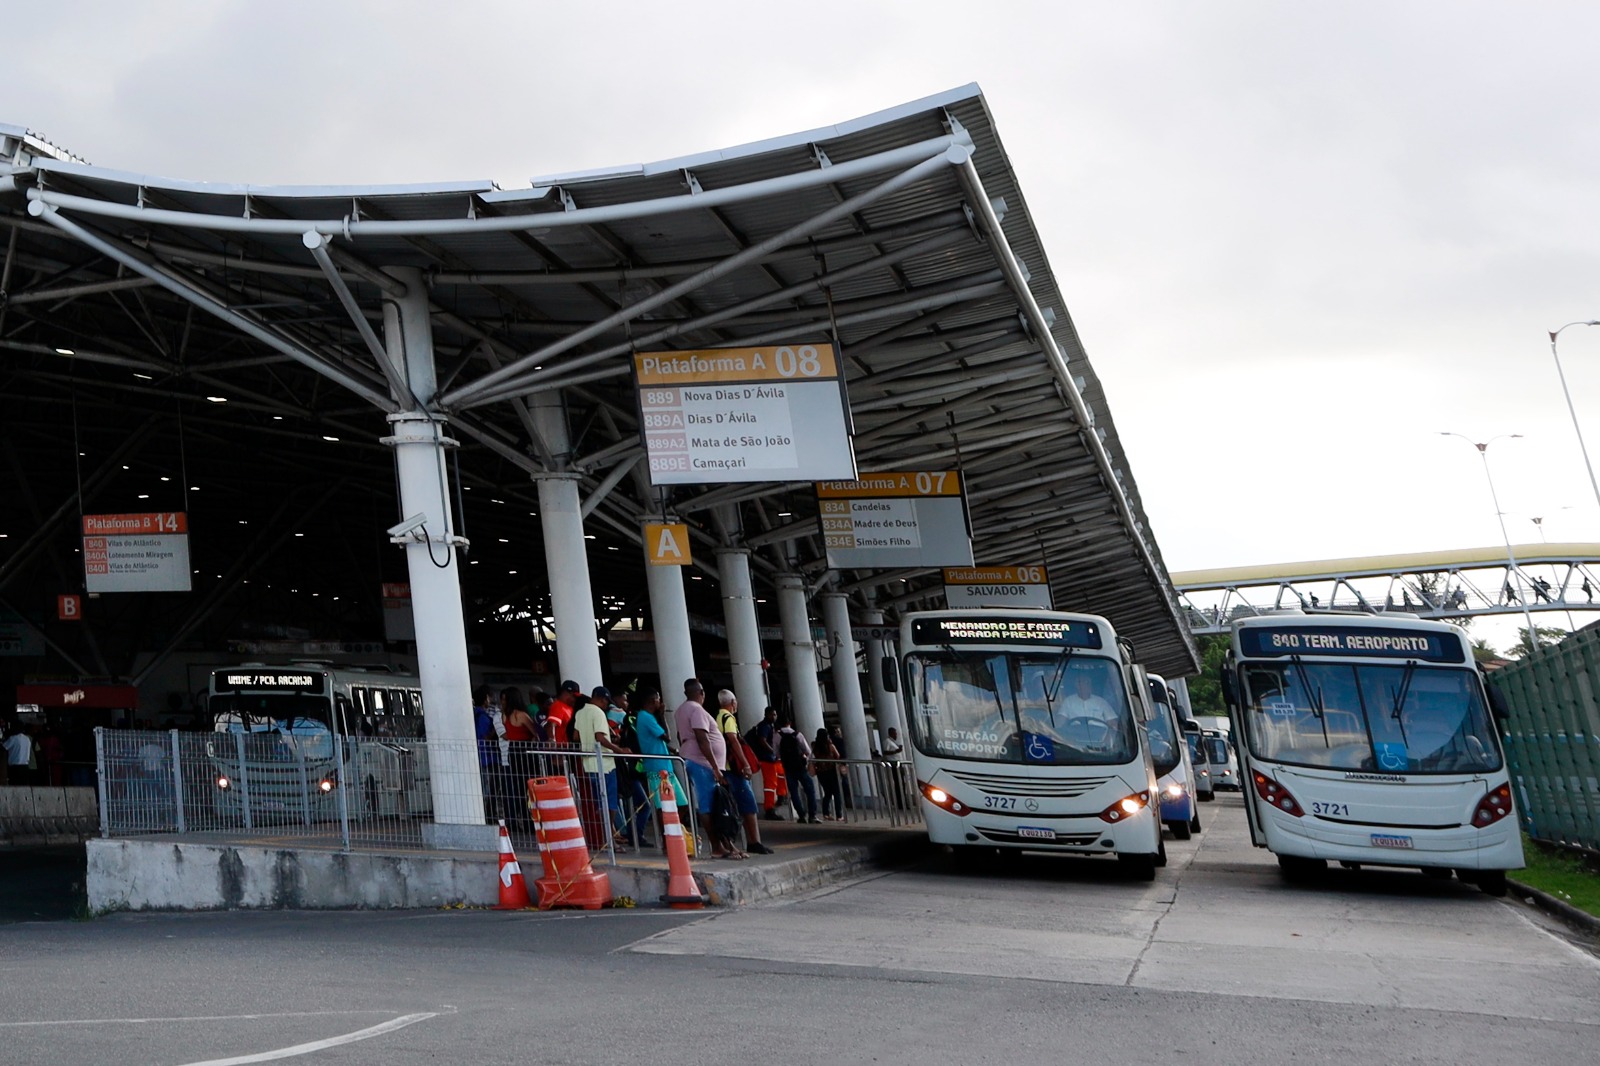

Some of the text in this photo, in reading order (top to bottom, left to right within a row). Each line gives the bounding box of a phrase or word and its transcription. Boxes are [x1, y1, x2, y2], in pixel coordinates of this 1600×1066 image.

[642, 345, 821, 377] Plataforma A 08
[646, 391, 674, 404] 889
[684, 390, 712, 402] Nova
[716, 389, 740, 400] Dias
[644, 412, 684, 428] 889A
[688, 413, 712, 424] Dias
[648, 438, 686, 450] 889A2
[691, 435, 792, 448] Mata de São João
[651, 458, 688, 471] 889E
[692, 456, 746, 472] Camaçari
[821, 472, 947, 494] Plataforma A 07
[824, 502, 845, 513] 834
[852, 502, 891, 512] Candeias
[87, 514, 178, 532] Plataforma B 14
[823, 520, 851, 530] 834A
[854, 518, 918, 529] Madre de Deus
[133, 539, 162, 547] Atlântico
[657, 528, 682, 558] A
[825, 536, 852, 547] 834E
[856, 536, 911, 546] Simões Filho
[146, 552, 174, 560] Miragem
[948, 567, 1041, 583] Plataforma A 06
[966, 585, 1027, 596] SALVADOR
[64, 598, 76, 616] B
[940, 622, 1070, 632] MENANDRO DE FARIA
[950, 630, 1063, 639] MORADA PREMIUM
[1272, 634, 1429, 650] 840 TERM. AEROPORTO
[944, 729, 998, 742] ESTAÇÃO
[936, 740, 1008, 756] AEROPORTO
[984, 796, 1016, 810] 3727
[1312, 802, 1348, 816] 3721
